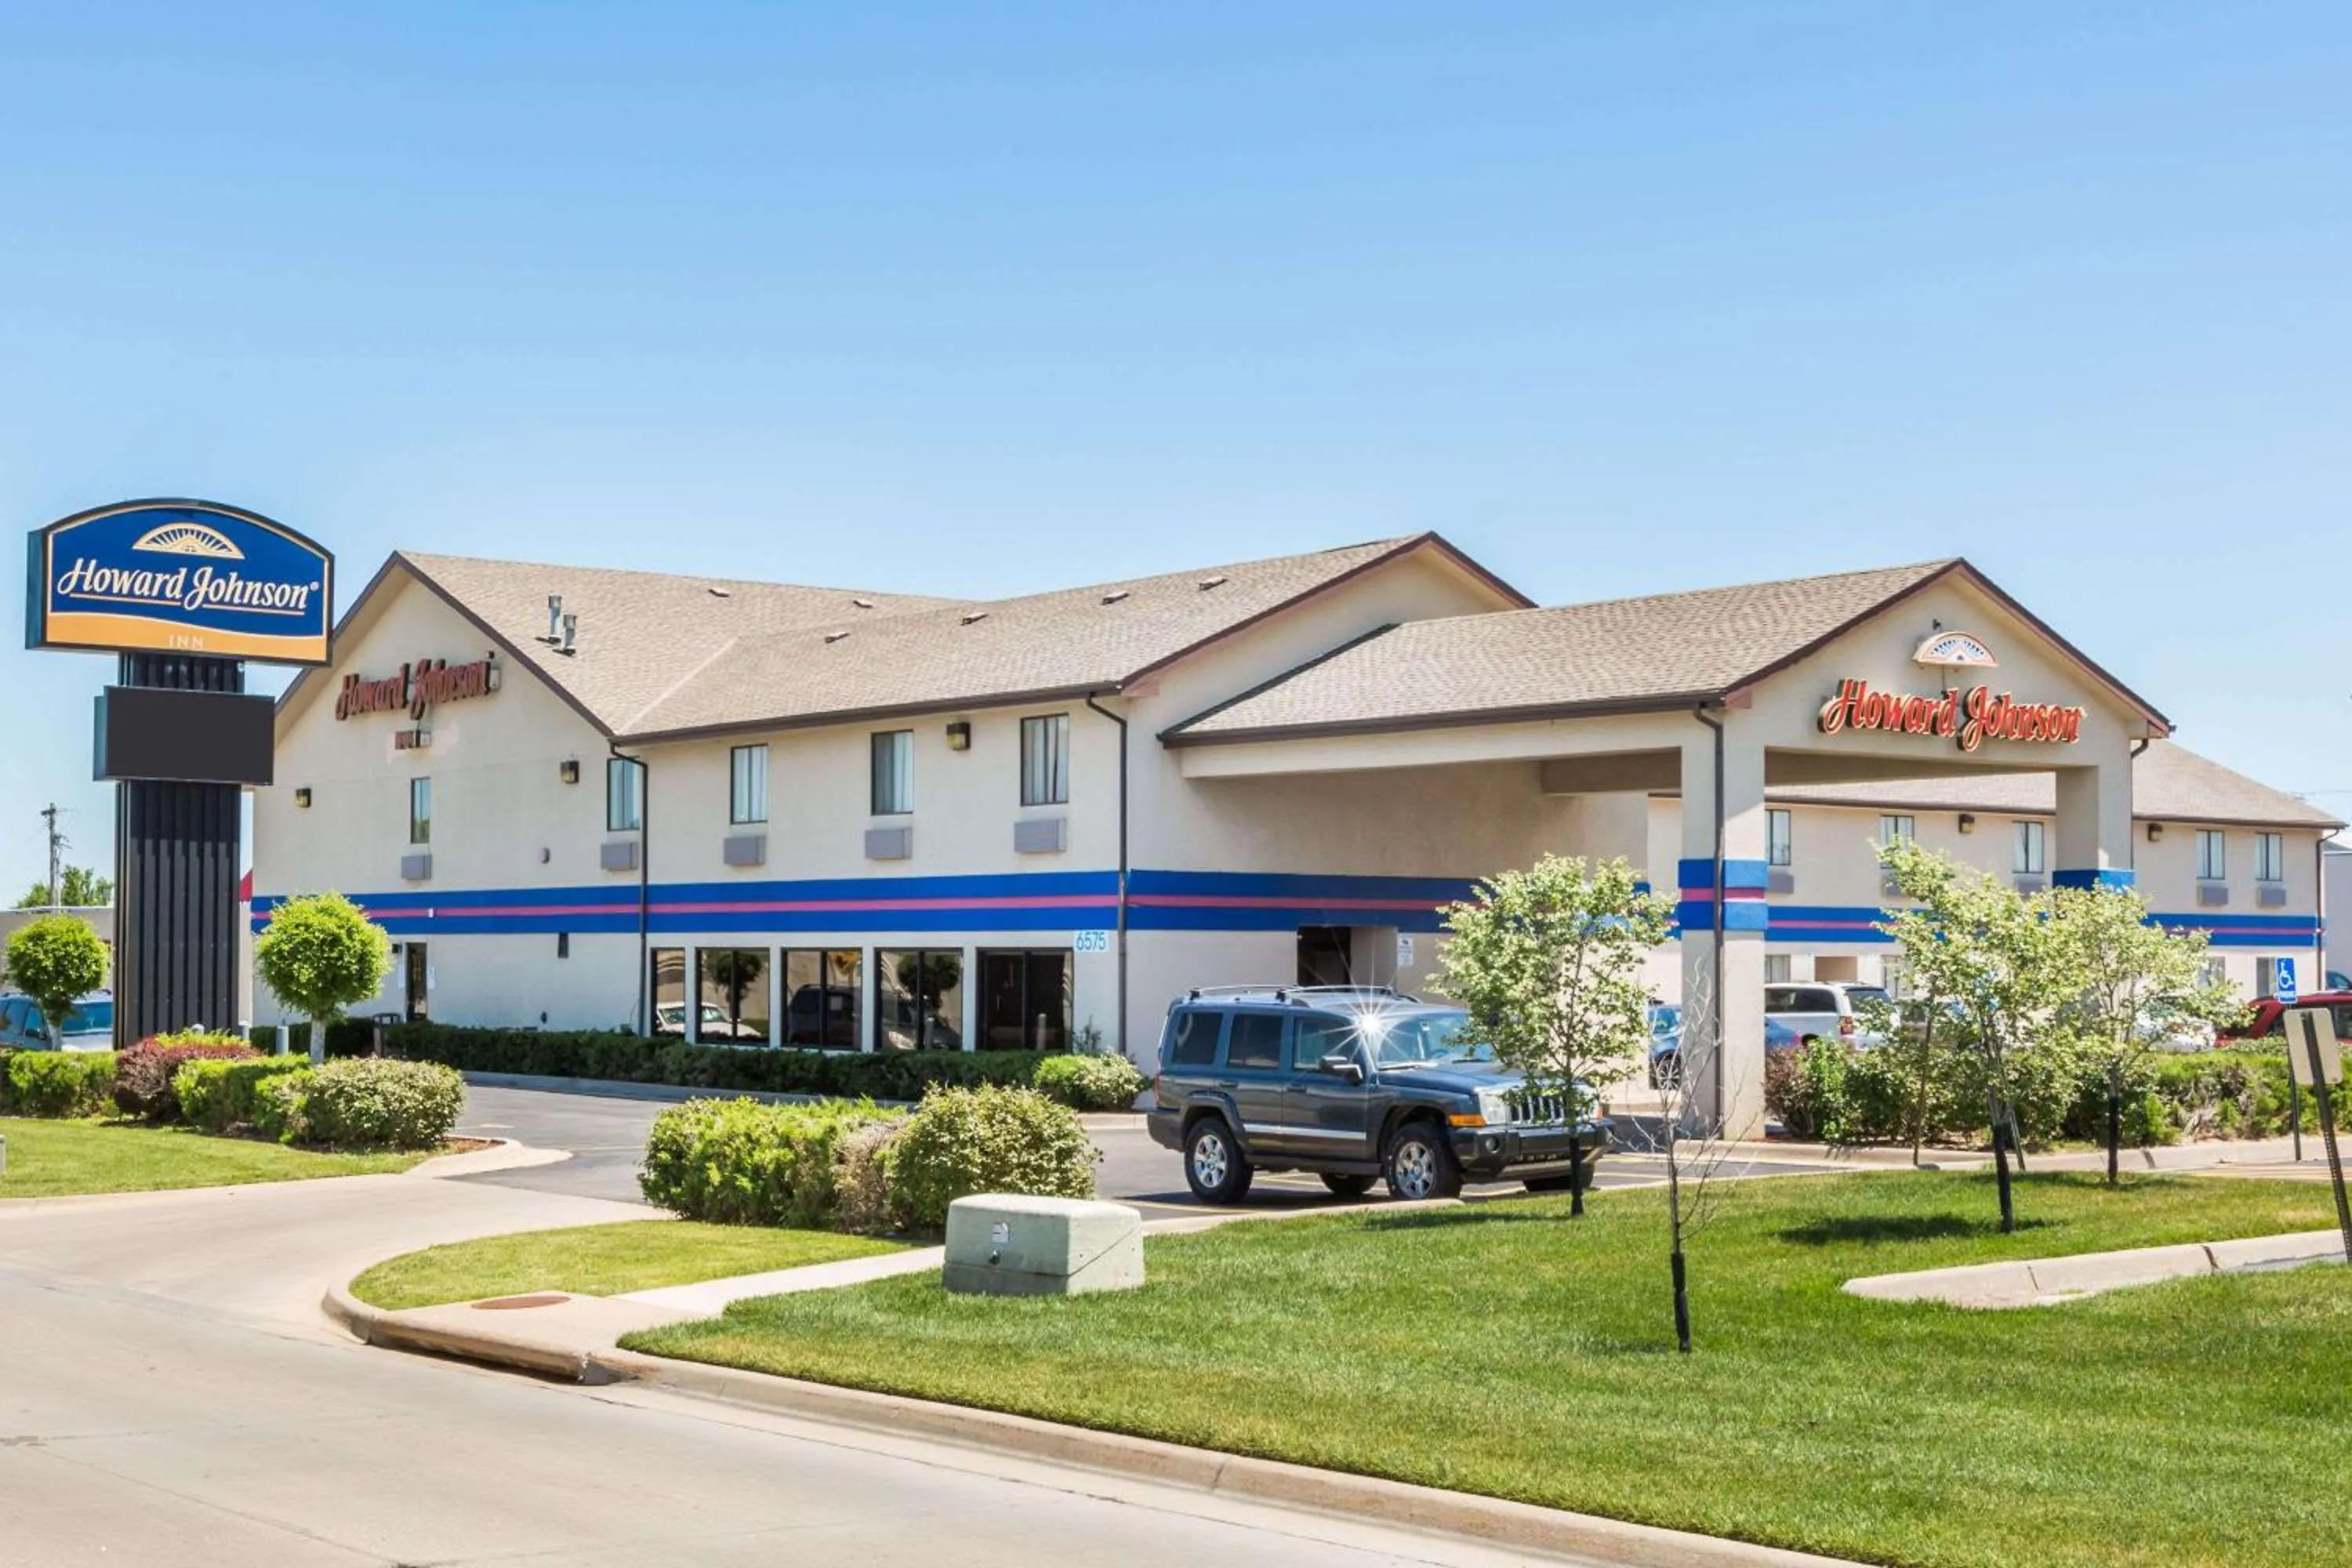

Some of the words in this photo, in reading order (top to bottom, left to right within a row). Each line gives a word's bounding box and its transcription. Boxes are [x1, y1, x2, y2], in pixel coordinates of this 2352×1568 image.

[57, 557, 187, 599] Howard
[169, 634, 205, 649] INN
[336, 662, 411, 721] Howard
[1818, 677, 1958, 736] Howard
[1958, 684, 2082, 753] Johnson
[1076, 931, 1106, 951] 6575
